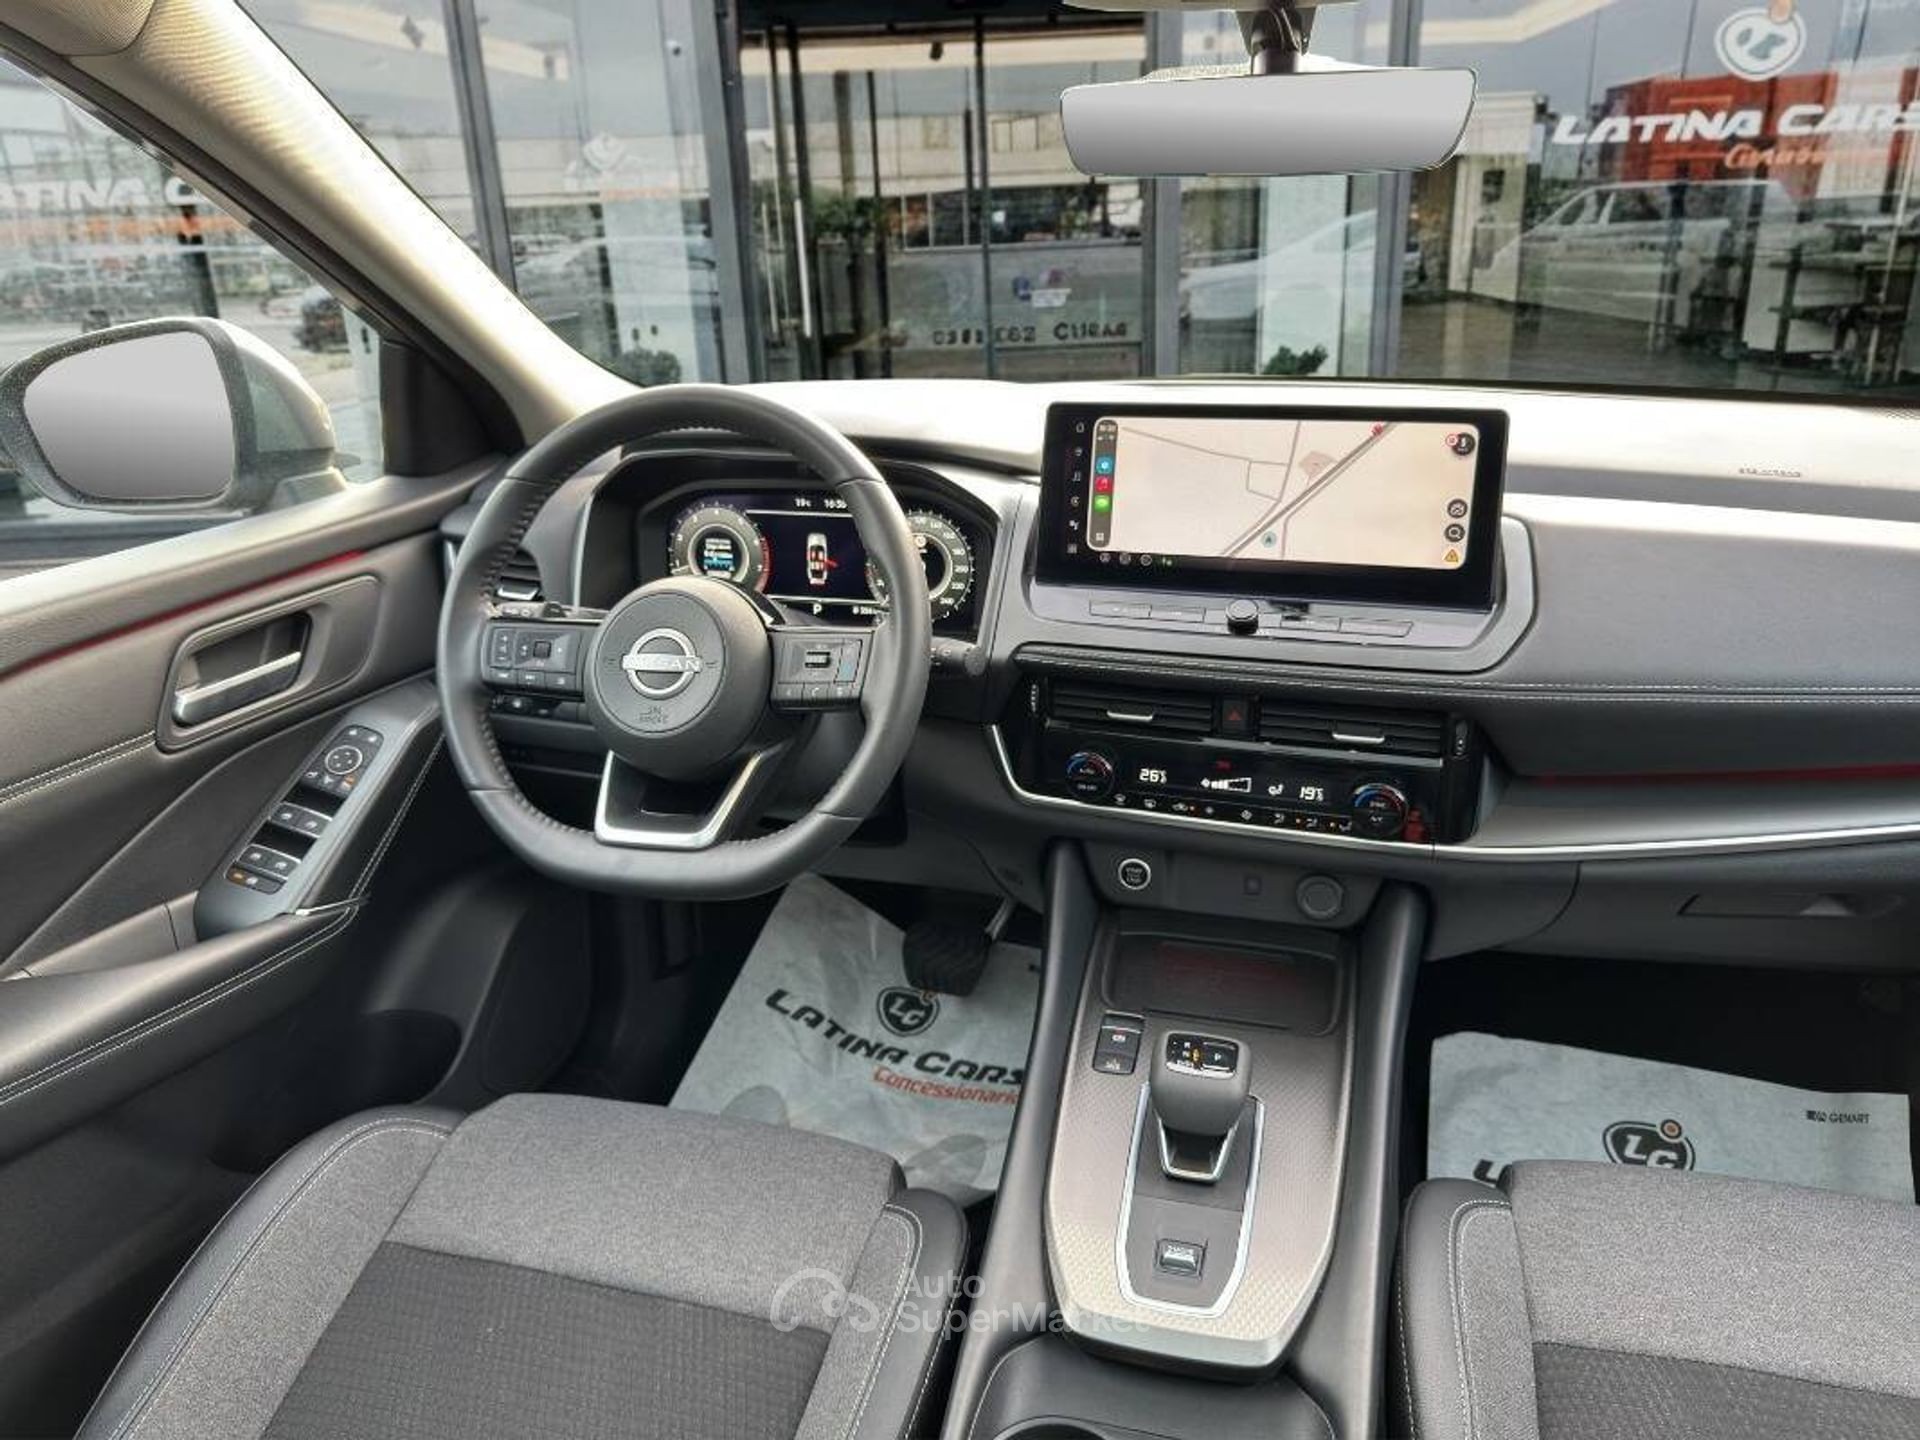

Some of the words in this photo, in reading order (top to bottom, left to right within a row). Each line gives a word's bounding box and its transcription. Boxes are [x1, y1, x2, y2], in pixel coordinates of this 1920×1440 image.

[1552, 110, 1763, 145] LATINA
[765, 987, 910, 1065] LATINA
[914, 1050, 1024, 1086] CARS
